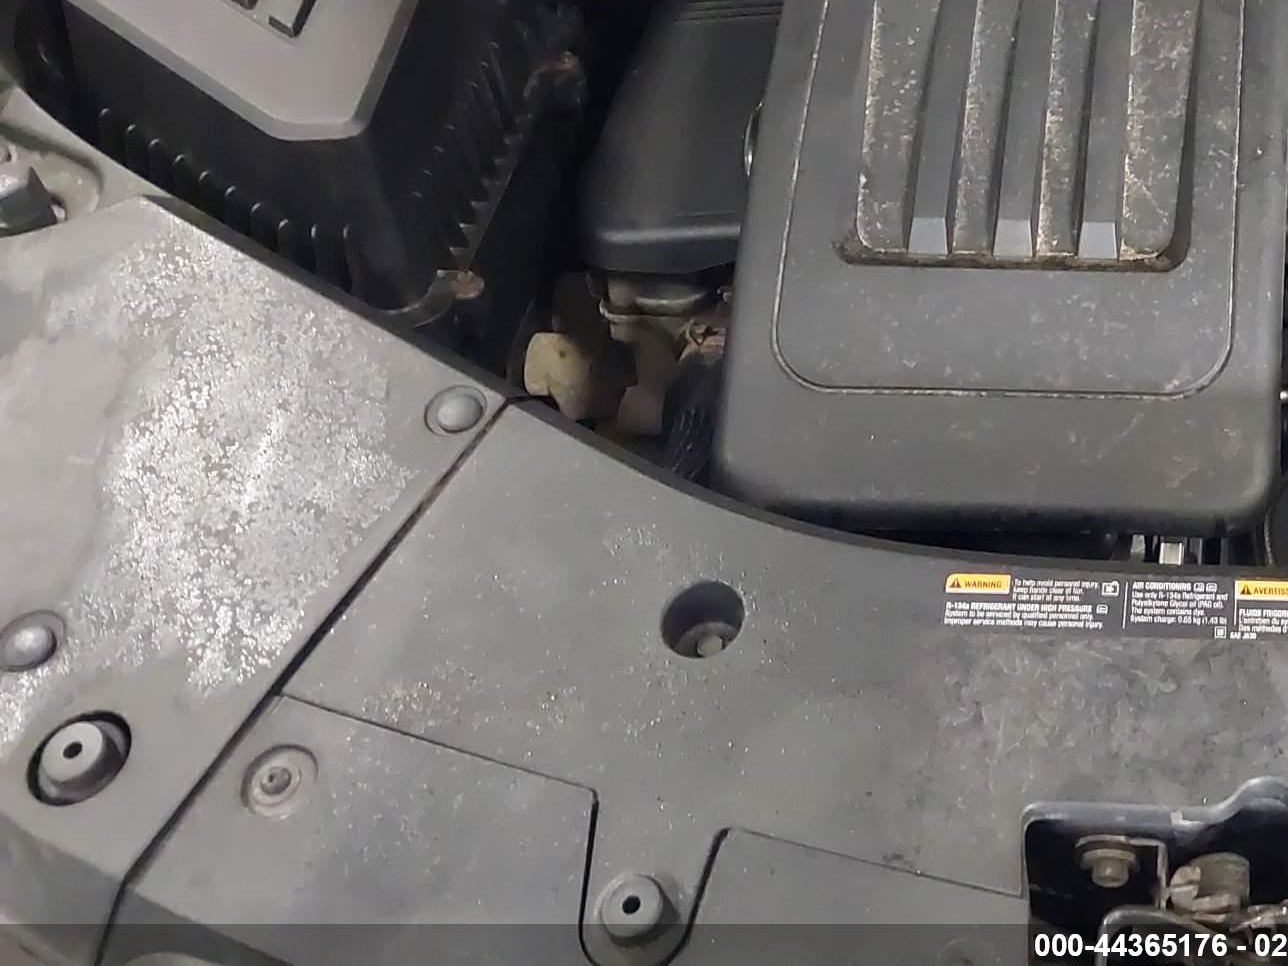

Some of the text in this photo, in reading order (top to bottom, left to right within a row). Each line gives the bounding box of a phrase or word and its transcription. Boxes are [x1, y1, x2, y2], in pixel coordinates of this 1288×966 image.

[1023, 579, 1035, 587] help
[1133, 582, 1191, 590] AIR CONDITIONING
[946, 601, 1092, 612] R-134a REFRIGERANT UNDER HIGH PRESSURE
[1058, 620, 1084, 628] personal
